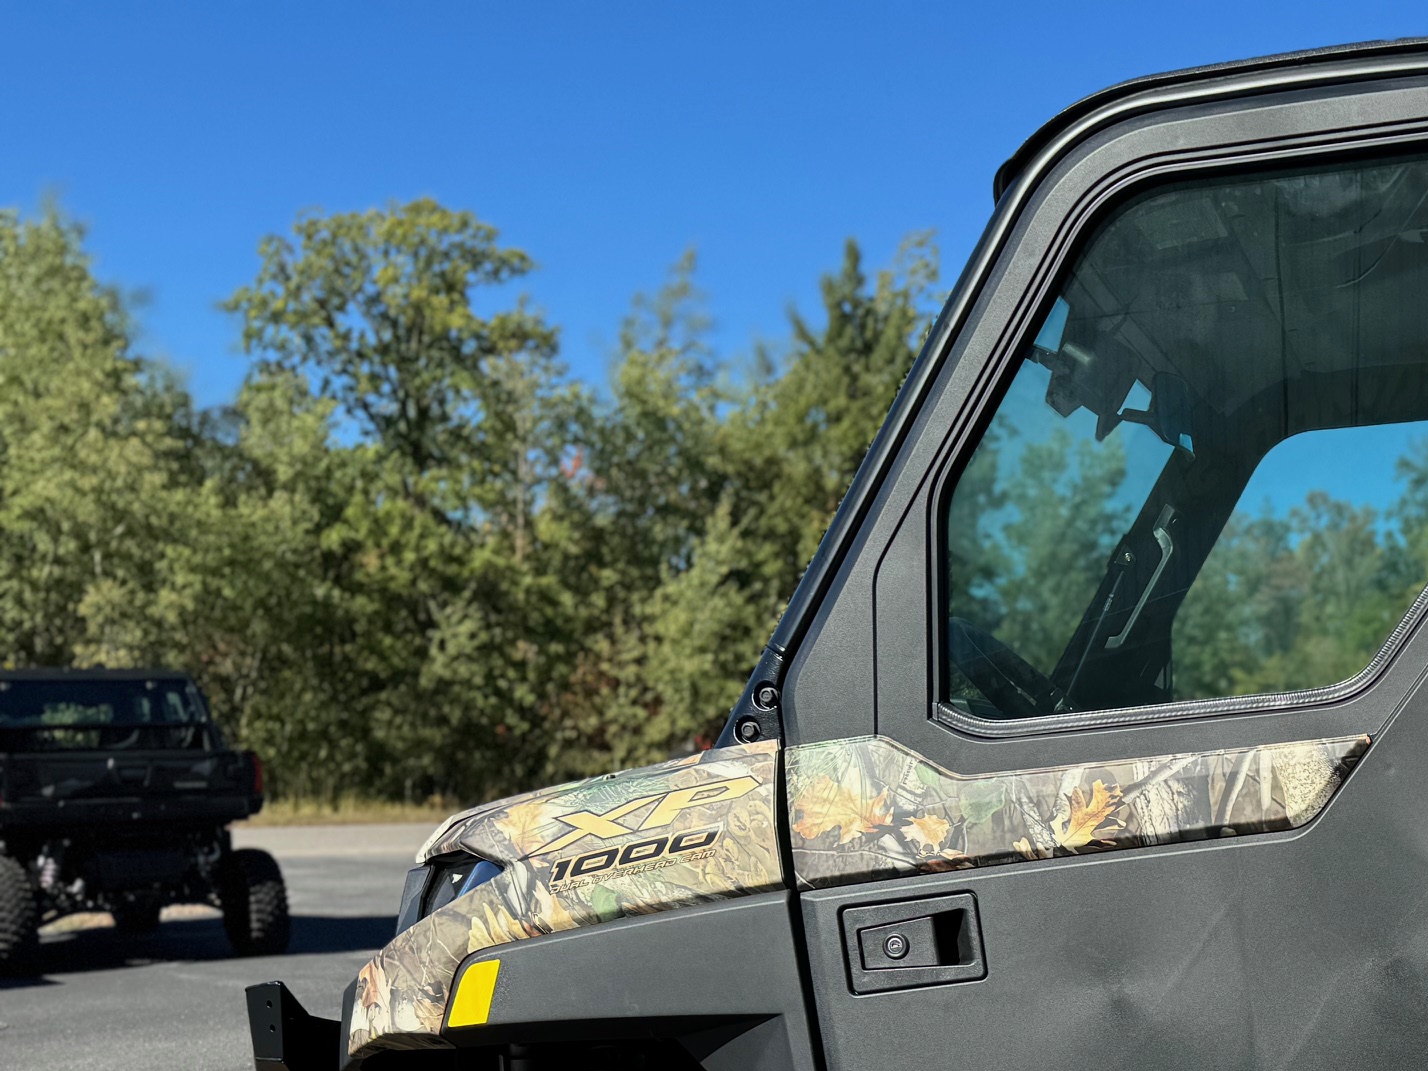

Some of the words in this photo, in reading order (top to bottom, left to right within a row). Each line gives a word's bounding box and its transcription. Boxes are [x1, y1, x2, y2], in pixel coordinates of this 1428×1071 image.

[517, 775, 762, 861] XP
[550, 822, 723, 885] 1000
[550, 879, 590, 894] DUAL
[592, 858, 678, 884] OVERHEAD
[679, 849, 717, 864] CAM
